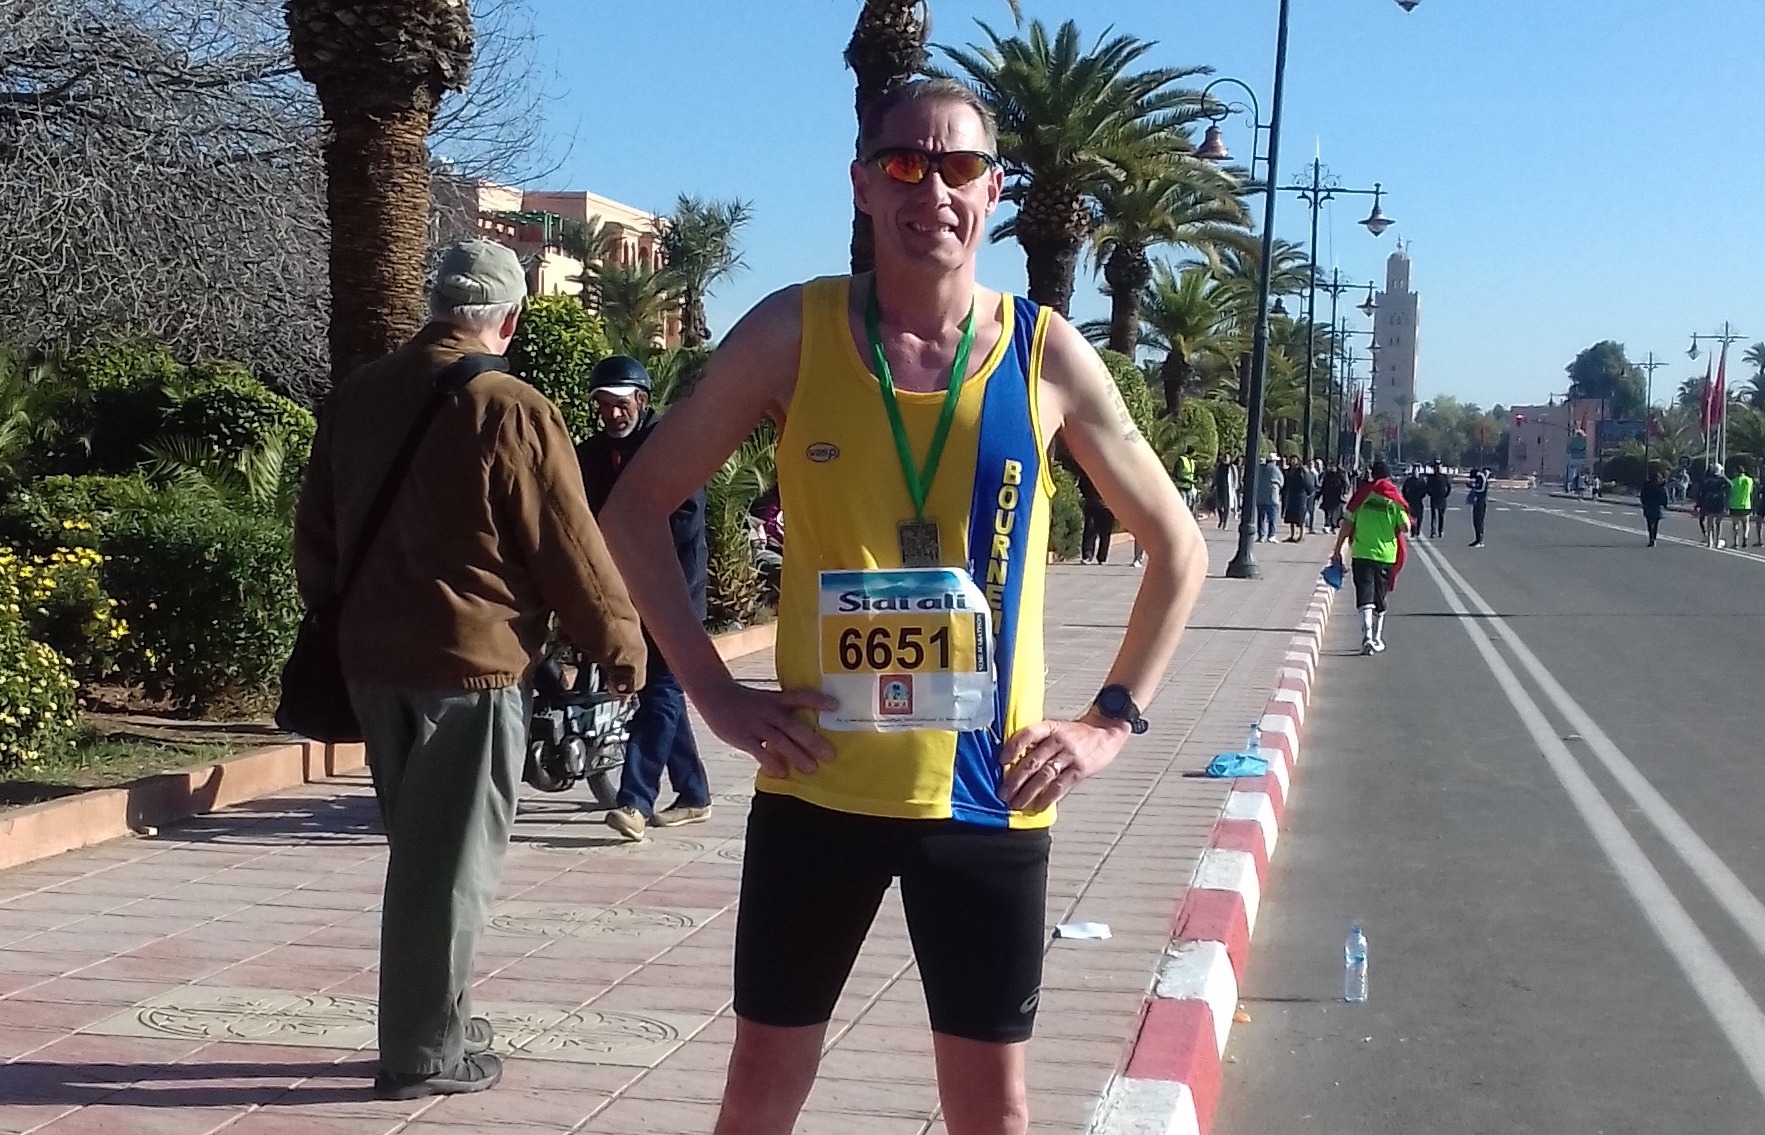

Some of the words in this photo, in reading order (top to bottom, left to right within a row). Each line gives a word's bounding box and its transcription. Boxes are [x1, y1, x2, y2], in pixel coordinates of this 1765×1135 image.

[838, 590, 909, 612] Sidi
[914, 593, 968, 610] ali
[838, 625, 949, 670] 6651
